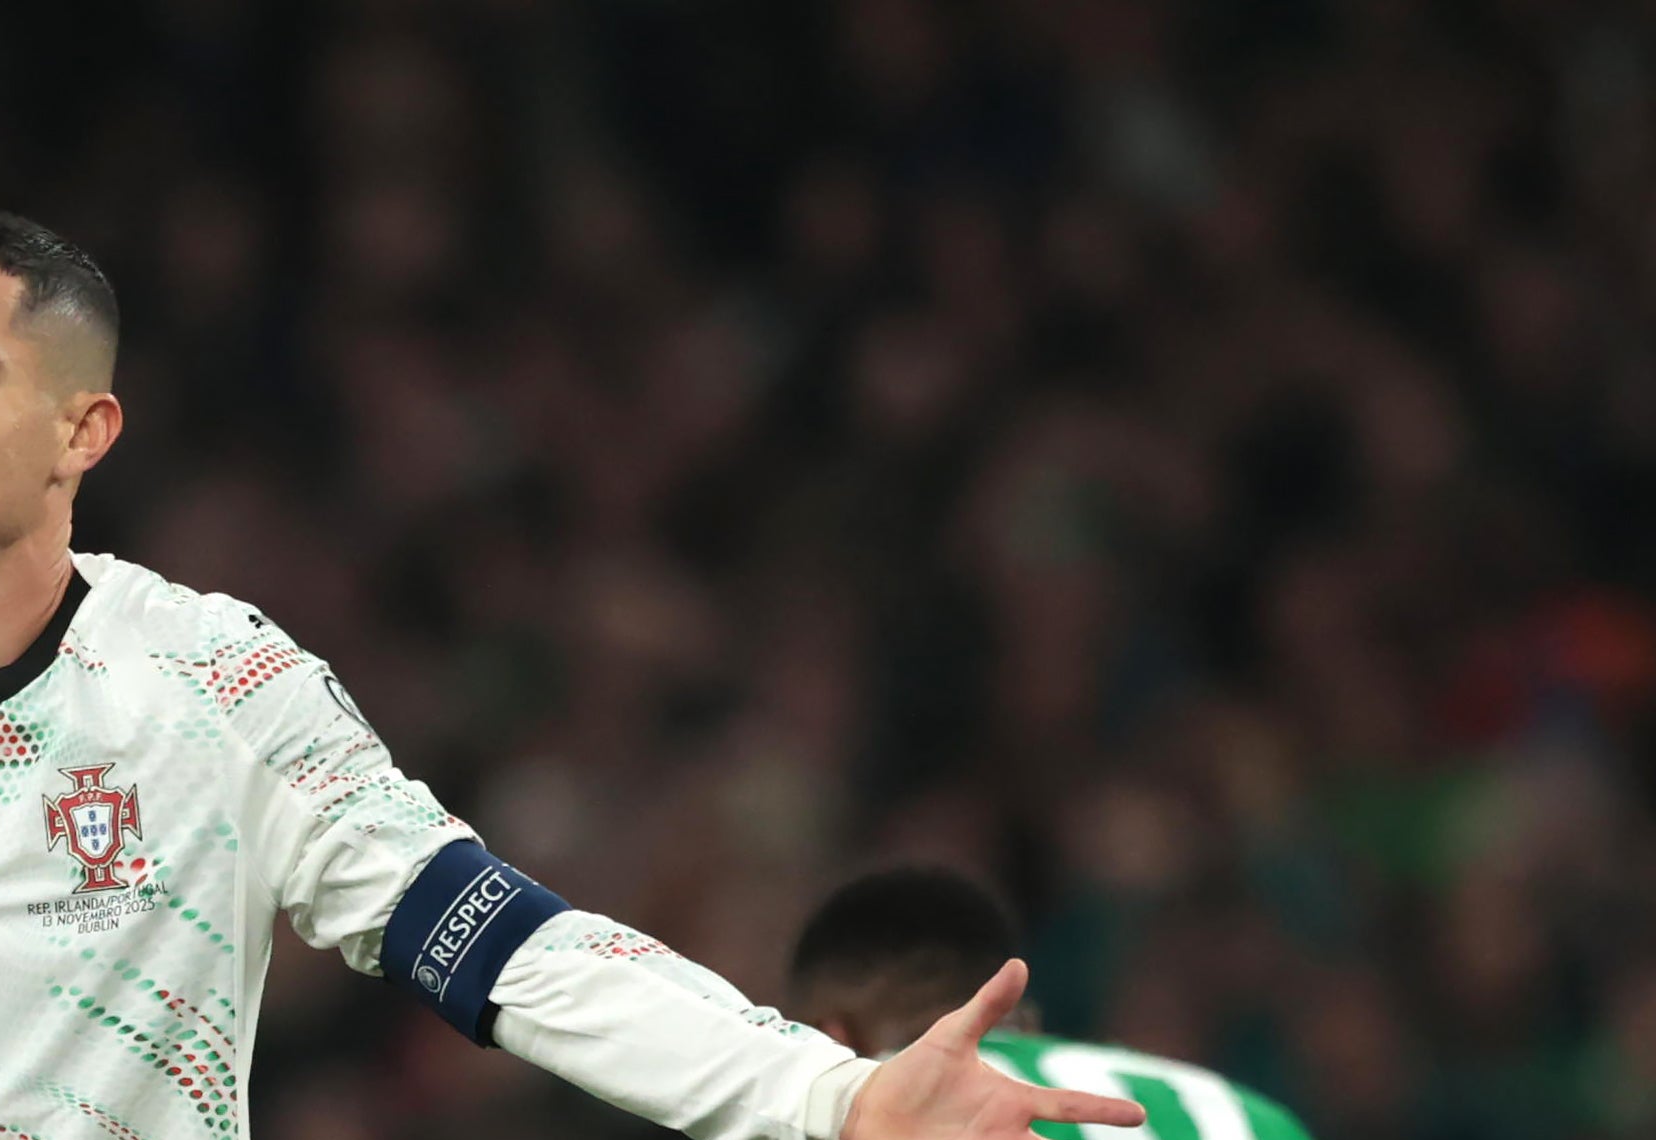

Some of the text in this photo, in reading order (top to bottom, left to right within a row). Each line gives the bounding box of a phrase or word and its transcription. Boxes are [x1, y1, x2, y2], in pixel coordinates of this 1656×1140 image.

[27, 881, 169, 915] REP. IRLANDA/PORTUGAL
[42, 898, 156, 928] 13 NOVEMBRO 2025
[77, 918, 120, 934] DUBLIN
[430, 871, 512, 967] RESPECT
